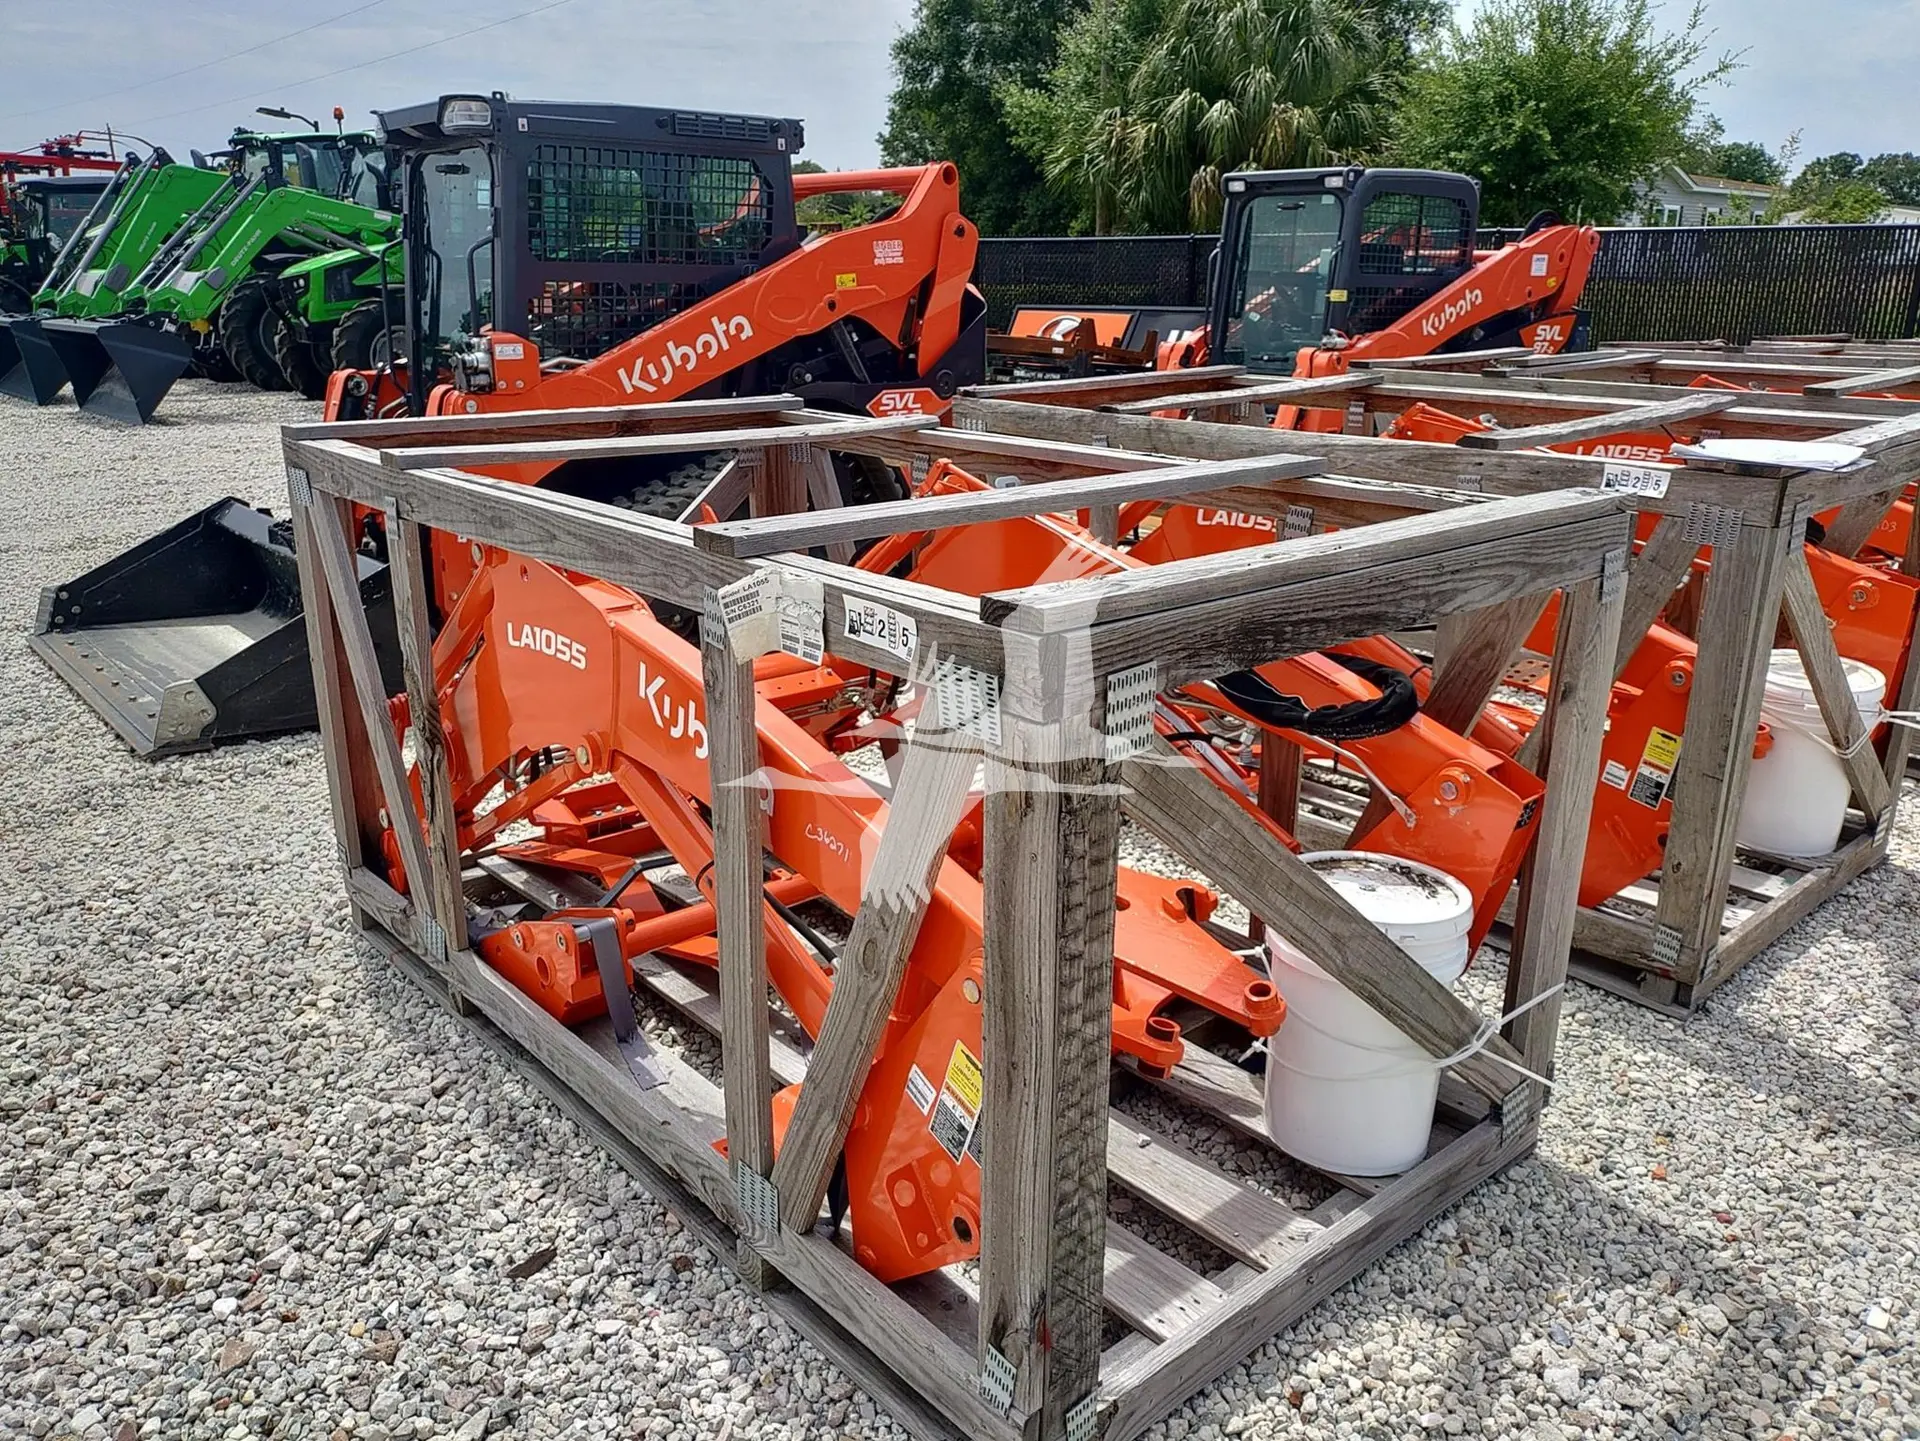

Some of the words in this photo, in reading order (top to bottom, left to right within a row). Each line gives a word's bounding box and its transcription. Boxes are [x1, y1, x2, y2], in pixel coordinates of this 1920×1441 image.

[1422, 288, 1482, 336] Kubota
[1534, 325, 1564, 341] SVL
[617, 315, 753, 394] Kubota
[879, 392, 922, 411] SVL
[1576, 444, 1664, 462] LA1055
[1632, 476, 1640, 489] 2
[1653, 480, 1661, 492] 5
[742, 576, 770, 592] LA1055
[737, 599, 760, 612] C6321
[878, 618, 887, 639] 2
[901, 626, 910, 648] 5
[506, 622, 587, 671] LA1055
